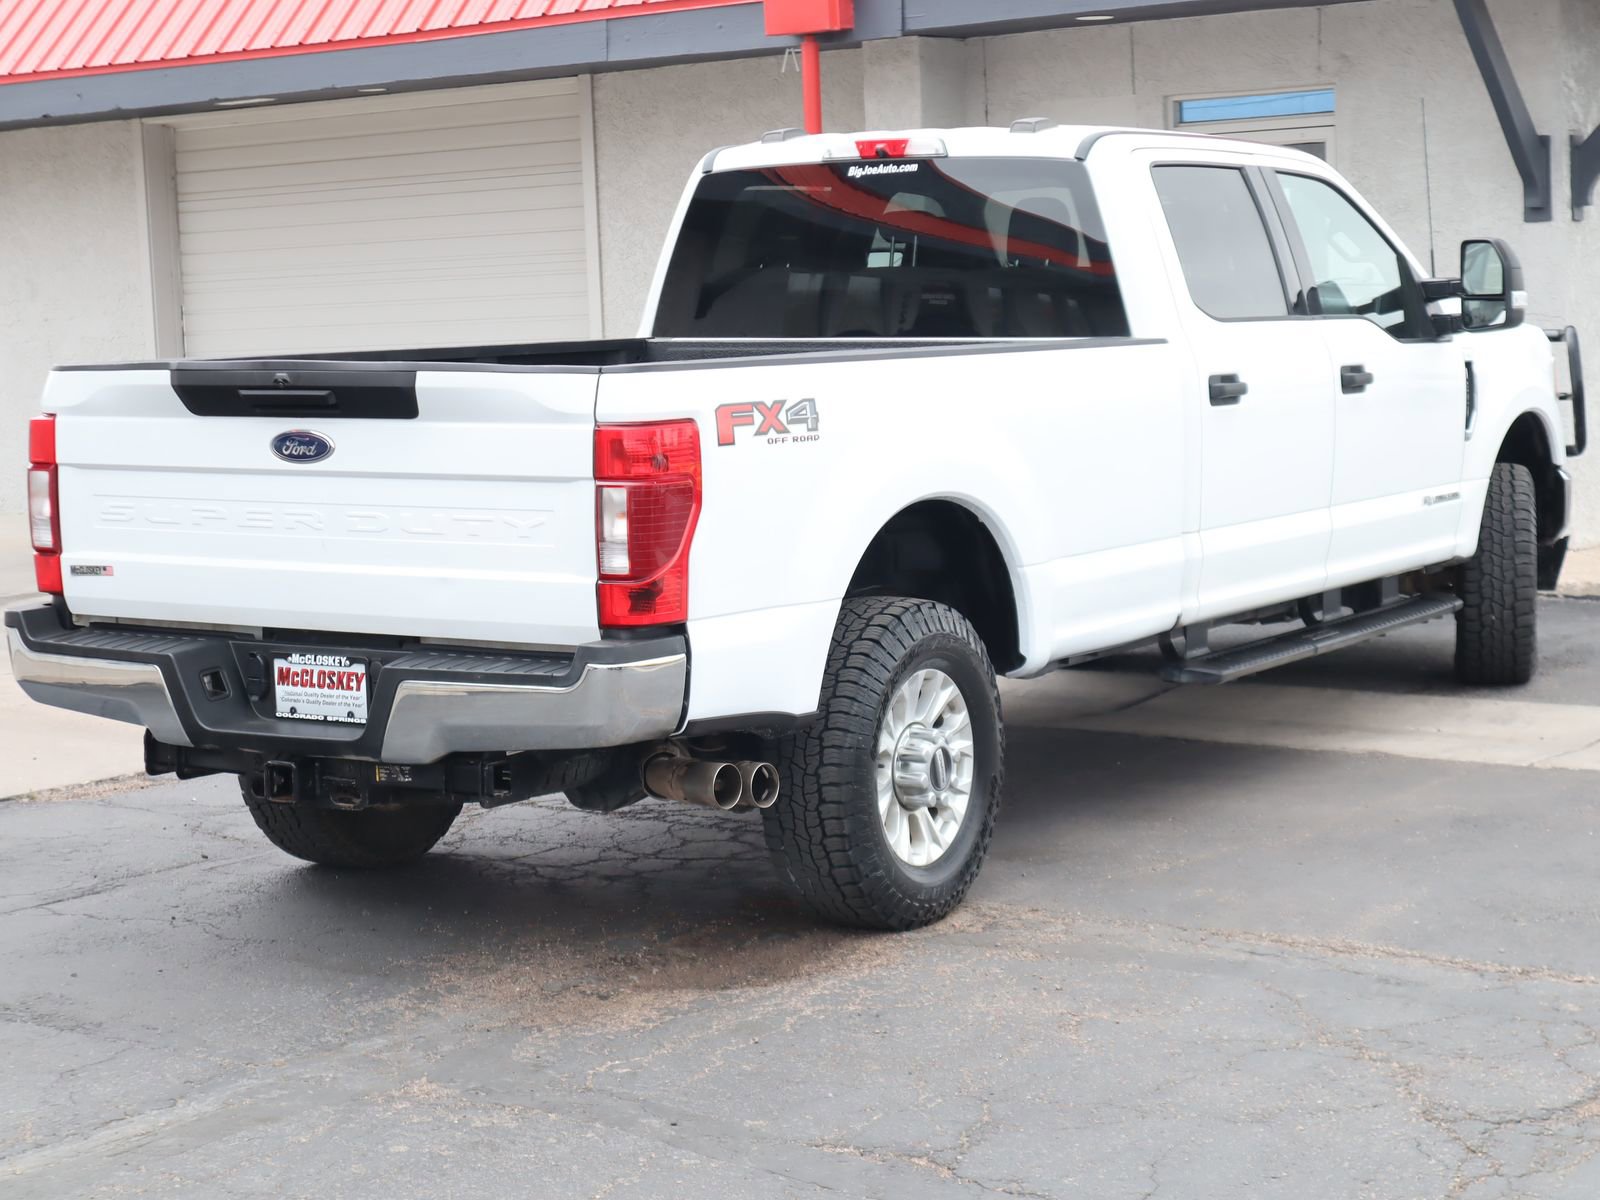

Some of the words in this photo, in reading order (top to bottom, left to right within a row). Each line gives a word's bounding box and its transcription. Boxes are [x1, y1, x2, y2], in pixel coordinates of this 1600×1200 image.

[848, 163, 918, 178] BigJoeAuto.com
[715, 398, 819, 447] FX4
[282, 436, 319, 456] Ford
[767, 437, 788, 445] OFF
[793, 434, 820, 443] ROAD
[99, 503, 325, 532] SUPER
[343, 511, 547, 539] DUTY
[291, 653, 346, 666] McCLOSKEY
[277, 666, 365, 692] McCLOSKEY
[275, 712, 324, 720] COLORADO
[326, 715, 367, 724] SPRINGS
